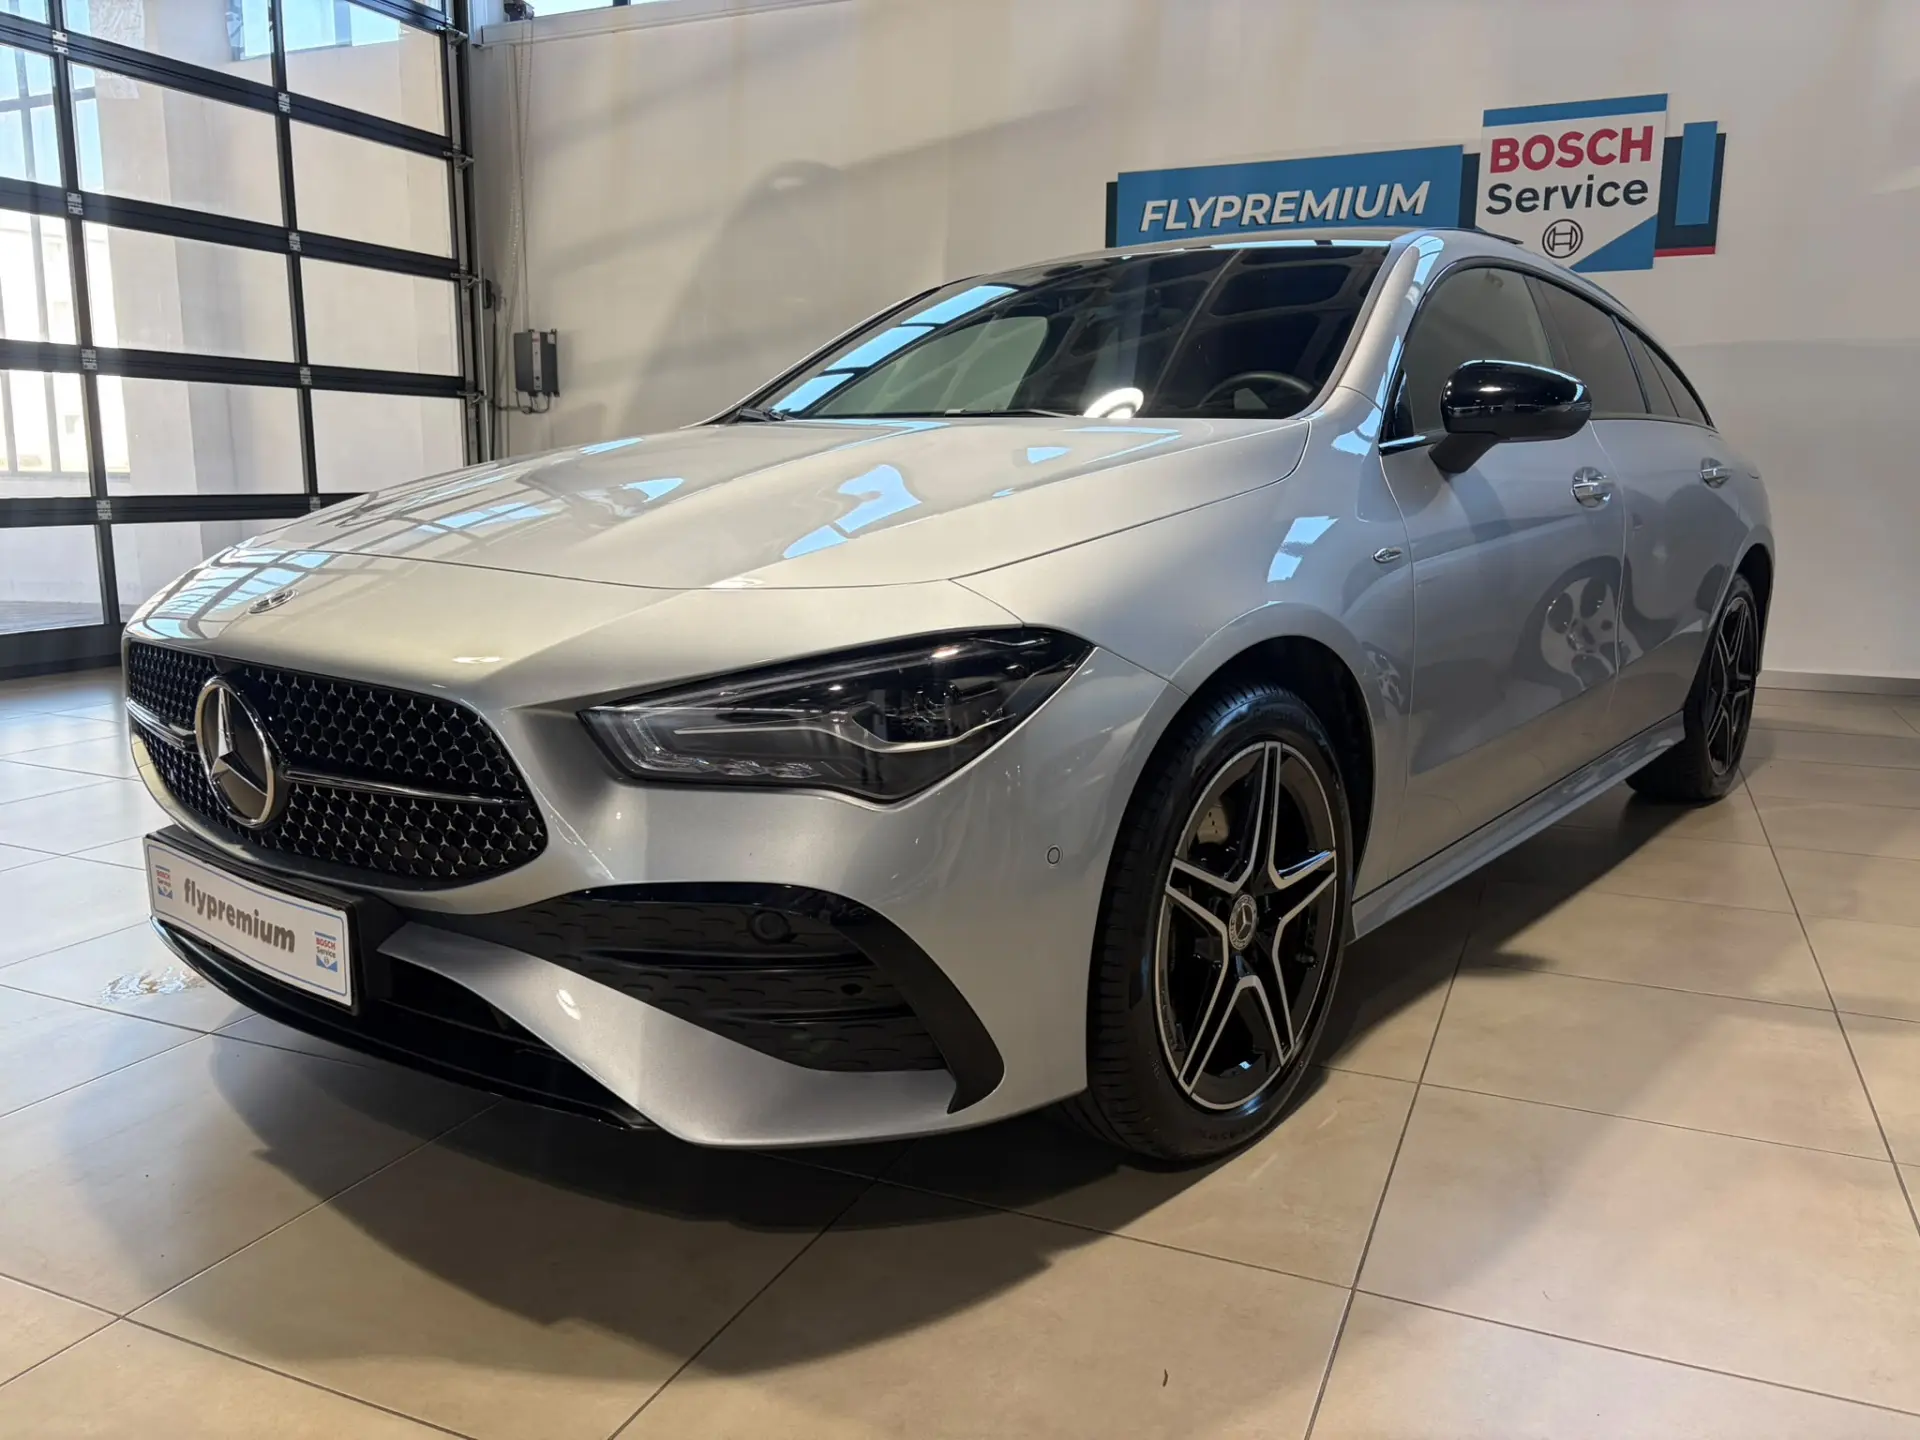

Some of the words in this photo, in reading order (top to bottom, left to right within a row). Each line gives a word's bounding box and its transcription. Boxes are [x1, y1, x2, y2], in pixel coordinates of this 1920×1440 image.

[1490, 126, 1654, 174] BOSCH
[1139, 181, 1431, 233] FLYPREMIUM
[1485, 174, 1649, 215] Service
[183, 878, 295, 953] flypremium
[316, 936, 336, 951] BOSCH
